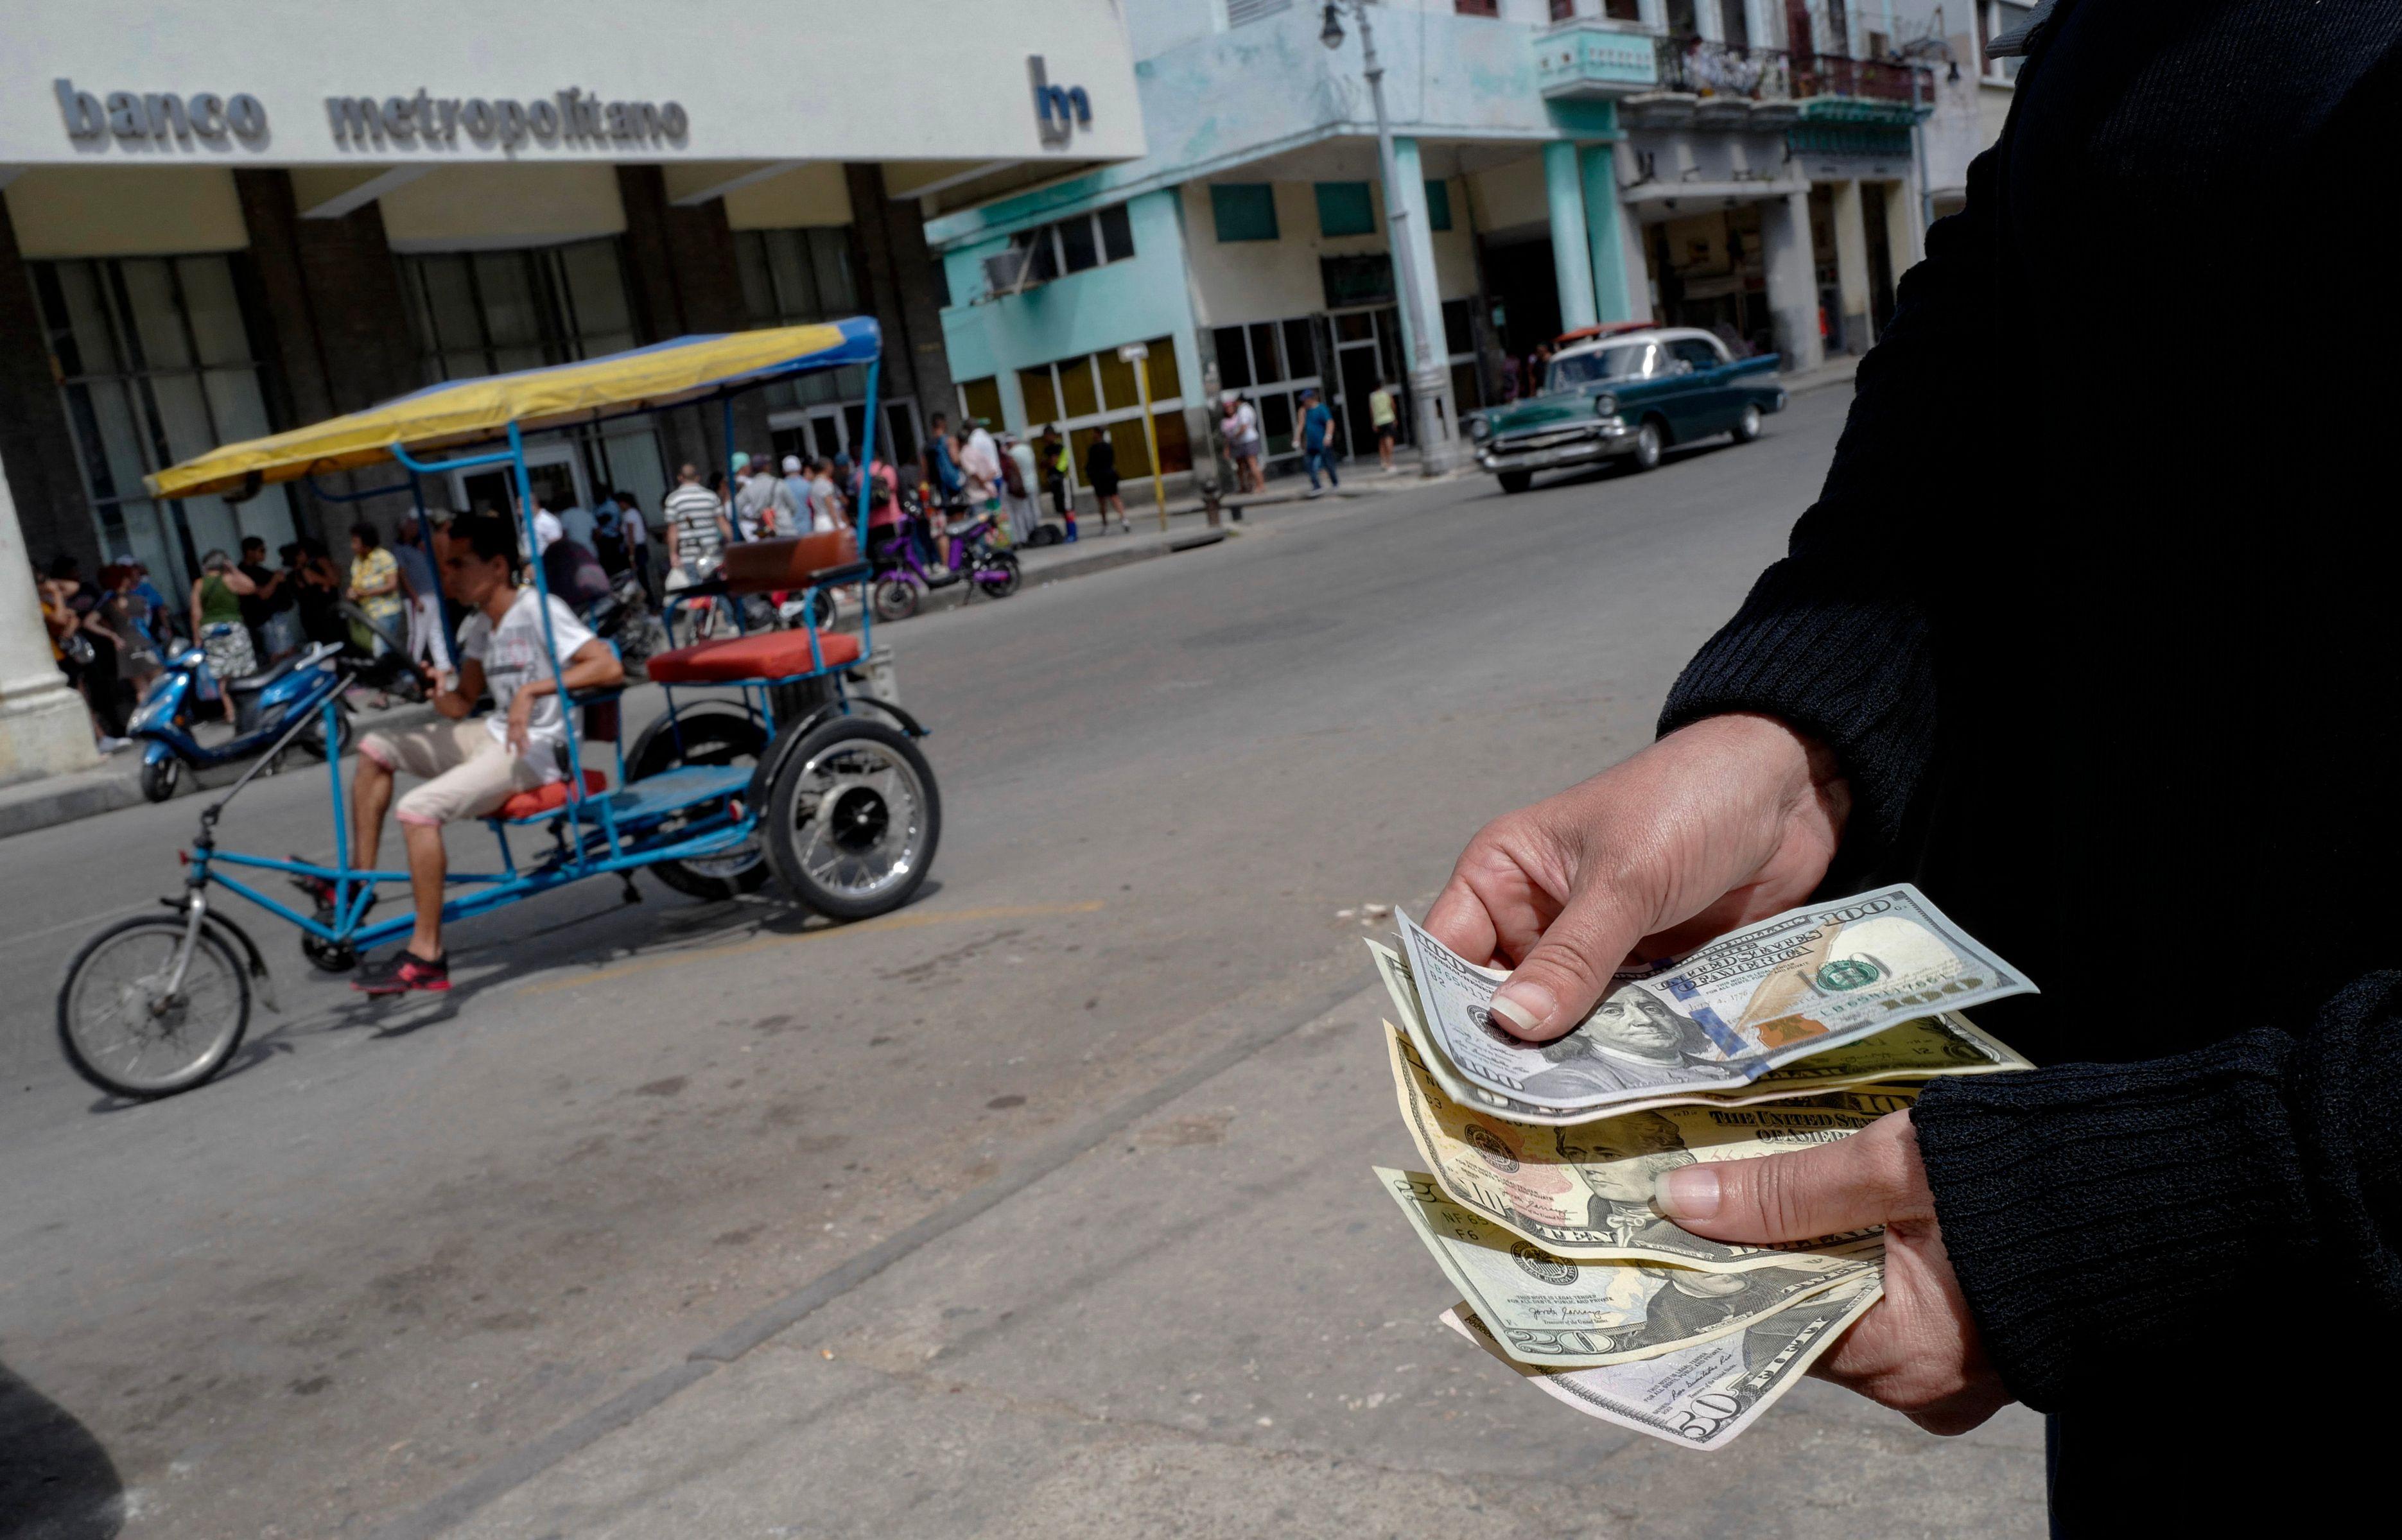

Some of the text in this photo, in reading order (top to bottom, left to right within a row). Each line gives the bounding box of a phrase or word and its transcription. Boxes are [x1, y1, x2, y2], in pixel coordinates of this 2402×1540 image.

[54, 78, 690, 158] banco metropolitano
[1819, 900, 1891, 926] 100
[1732, 916, 1806, 943] DOLLARS
[1651, 930, 1823, 991] UNITED STATES
[1678, 974, 1710, 992] OF
[1709, 946, 1814, 983] AMERICA
[1787, 962, 1809, 971] PRIVATE
[1460, 1059, 1526, 1091] 100
[1709, 1111, 1756, 1127] THE
[1756, 1111, 1834, 1127] UNITED
[1835, 1114, 1874, 1129] STA
[1756, 1129, 1785, 1144] OF
[1458, 1177, 1508, 1217] 10
[1466, 1214, 1499, 1226] 65
[1455, 1229, 1479, 1241] F6
[1535, 1224, 1617, 1243] TEN
[1504, 1330, 1617, 1354] 20
[1647, 1385, 1660, 1394] THIS
[1658, 1376, 1673, 1386] NOTE
[1675, 1365, 1692, 1374] LEGAL
[1644, 1394, 1656, 1403] FOR
[1667, 1394, 1742, 1439] 50
